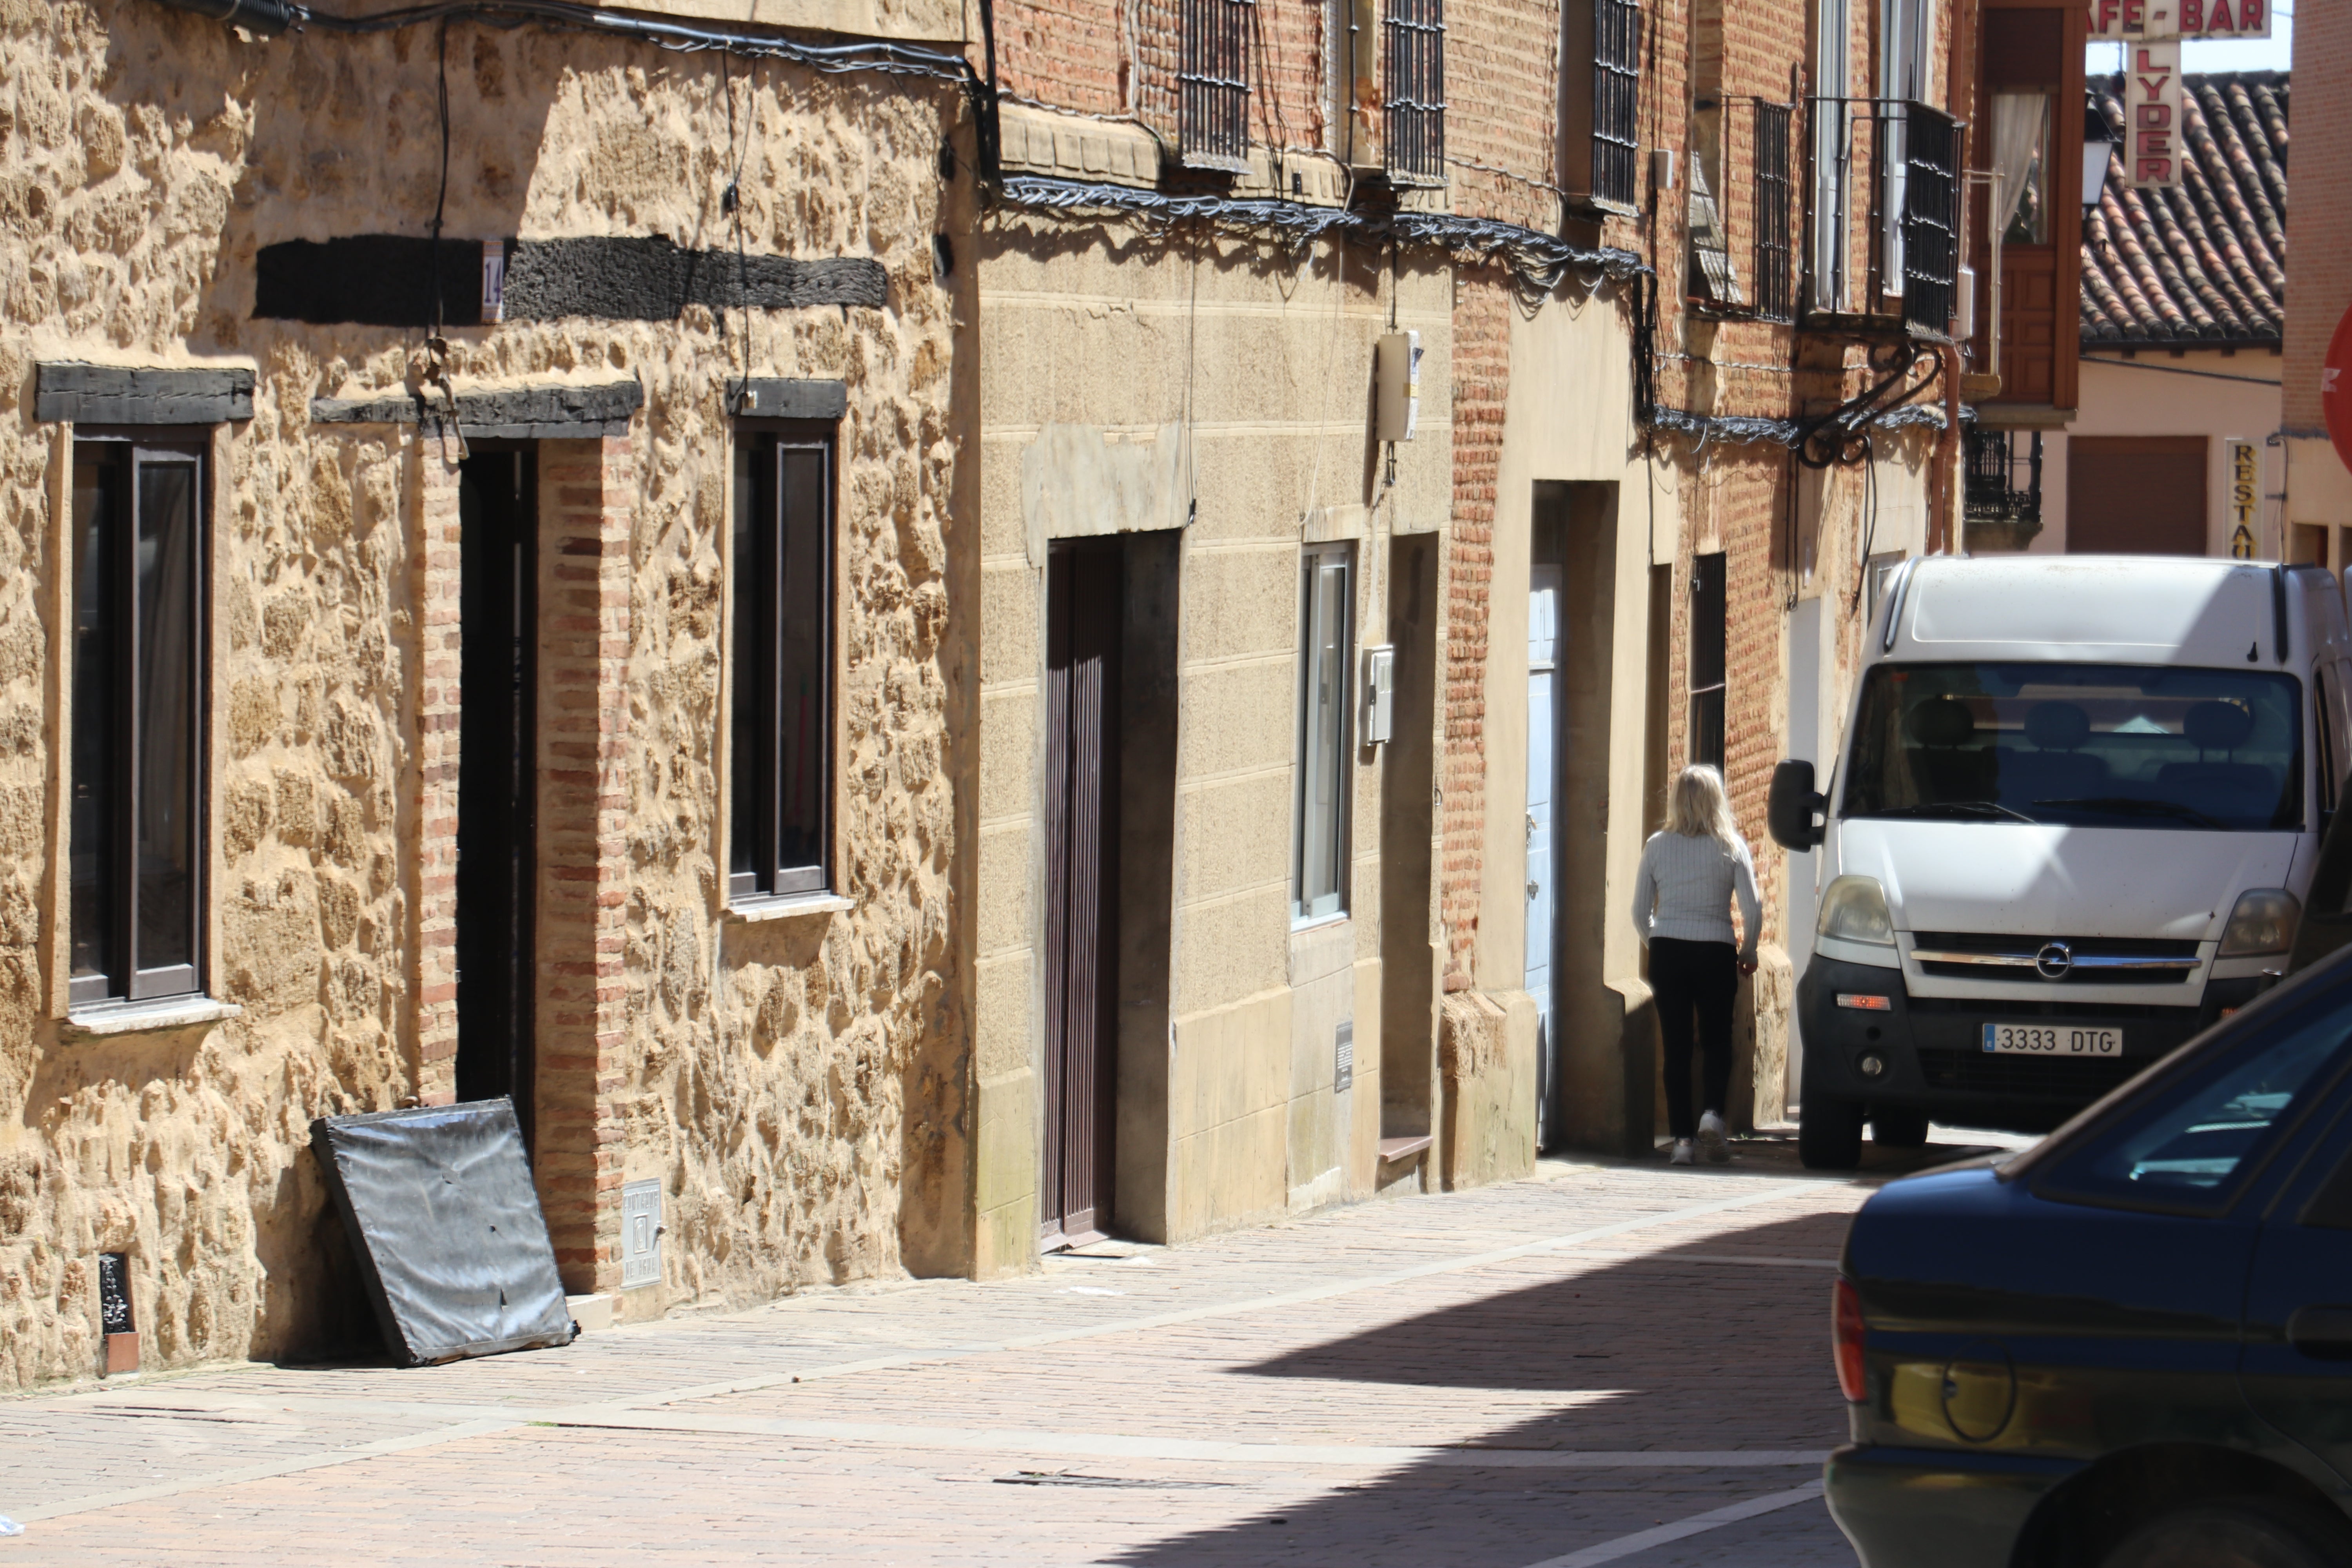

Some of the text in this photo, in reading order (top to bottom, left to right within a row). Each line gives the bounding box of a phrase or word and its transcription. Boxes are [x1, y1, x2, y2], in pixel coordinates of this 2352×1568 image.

[2137, 49, 2171, 182] LYDER
[485, 260, 503, 304] 14
[2001, 1029, 2113, 1053] 3333 DTG
[625, 1256, 657, 1279] DE AGUA
